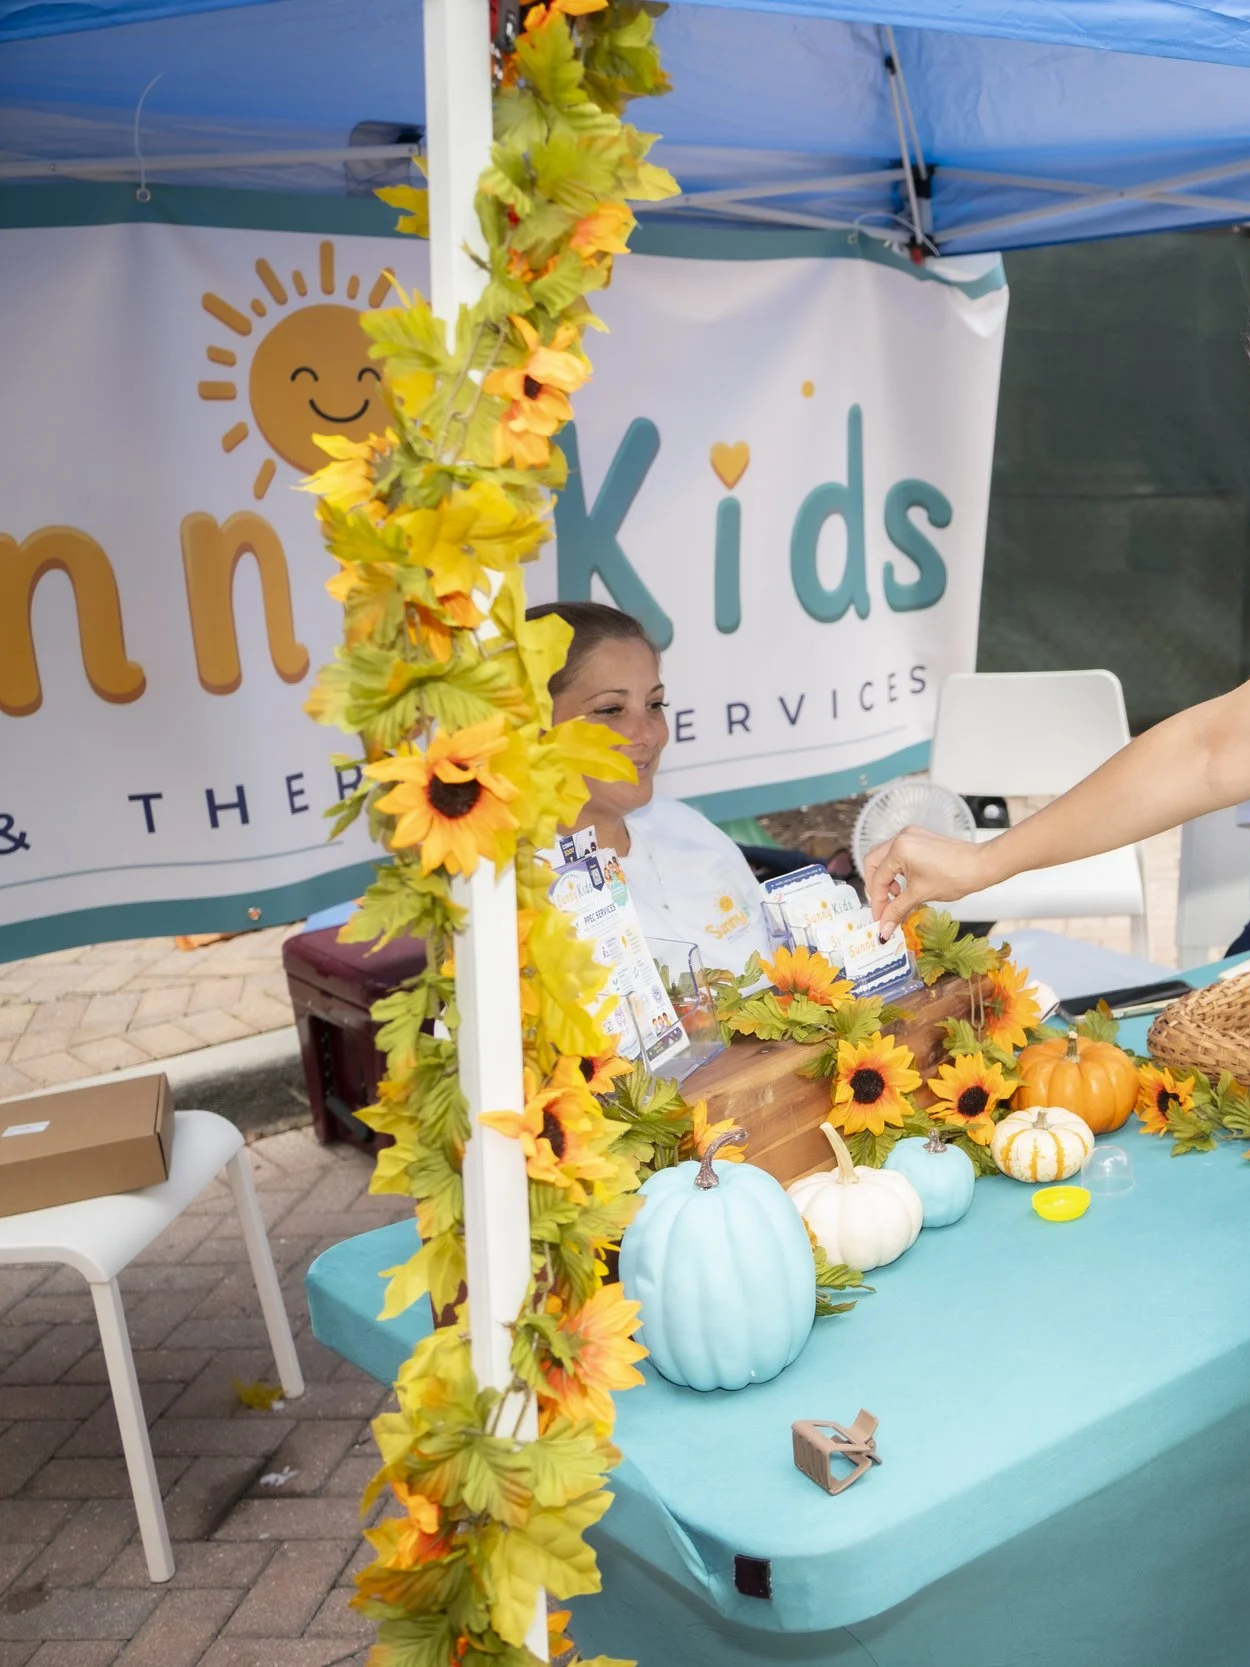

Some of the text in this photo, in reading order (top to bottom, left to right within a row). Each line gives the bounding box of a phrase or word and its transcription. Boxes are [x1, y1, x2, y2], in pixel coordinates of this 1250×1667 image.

[552, 403, 952, 652] Kids
[128, 765, 363, 834] THER
[674, 665, 928, 743] ERVICES
[804, 899, 853, 926] Sunny Kids
[849, 940, 876, 958] Sunny
